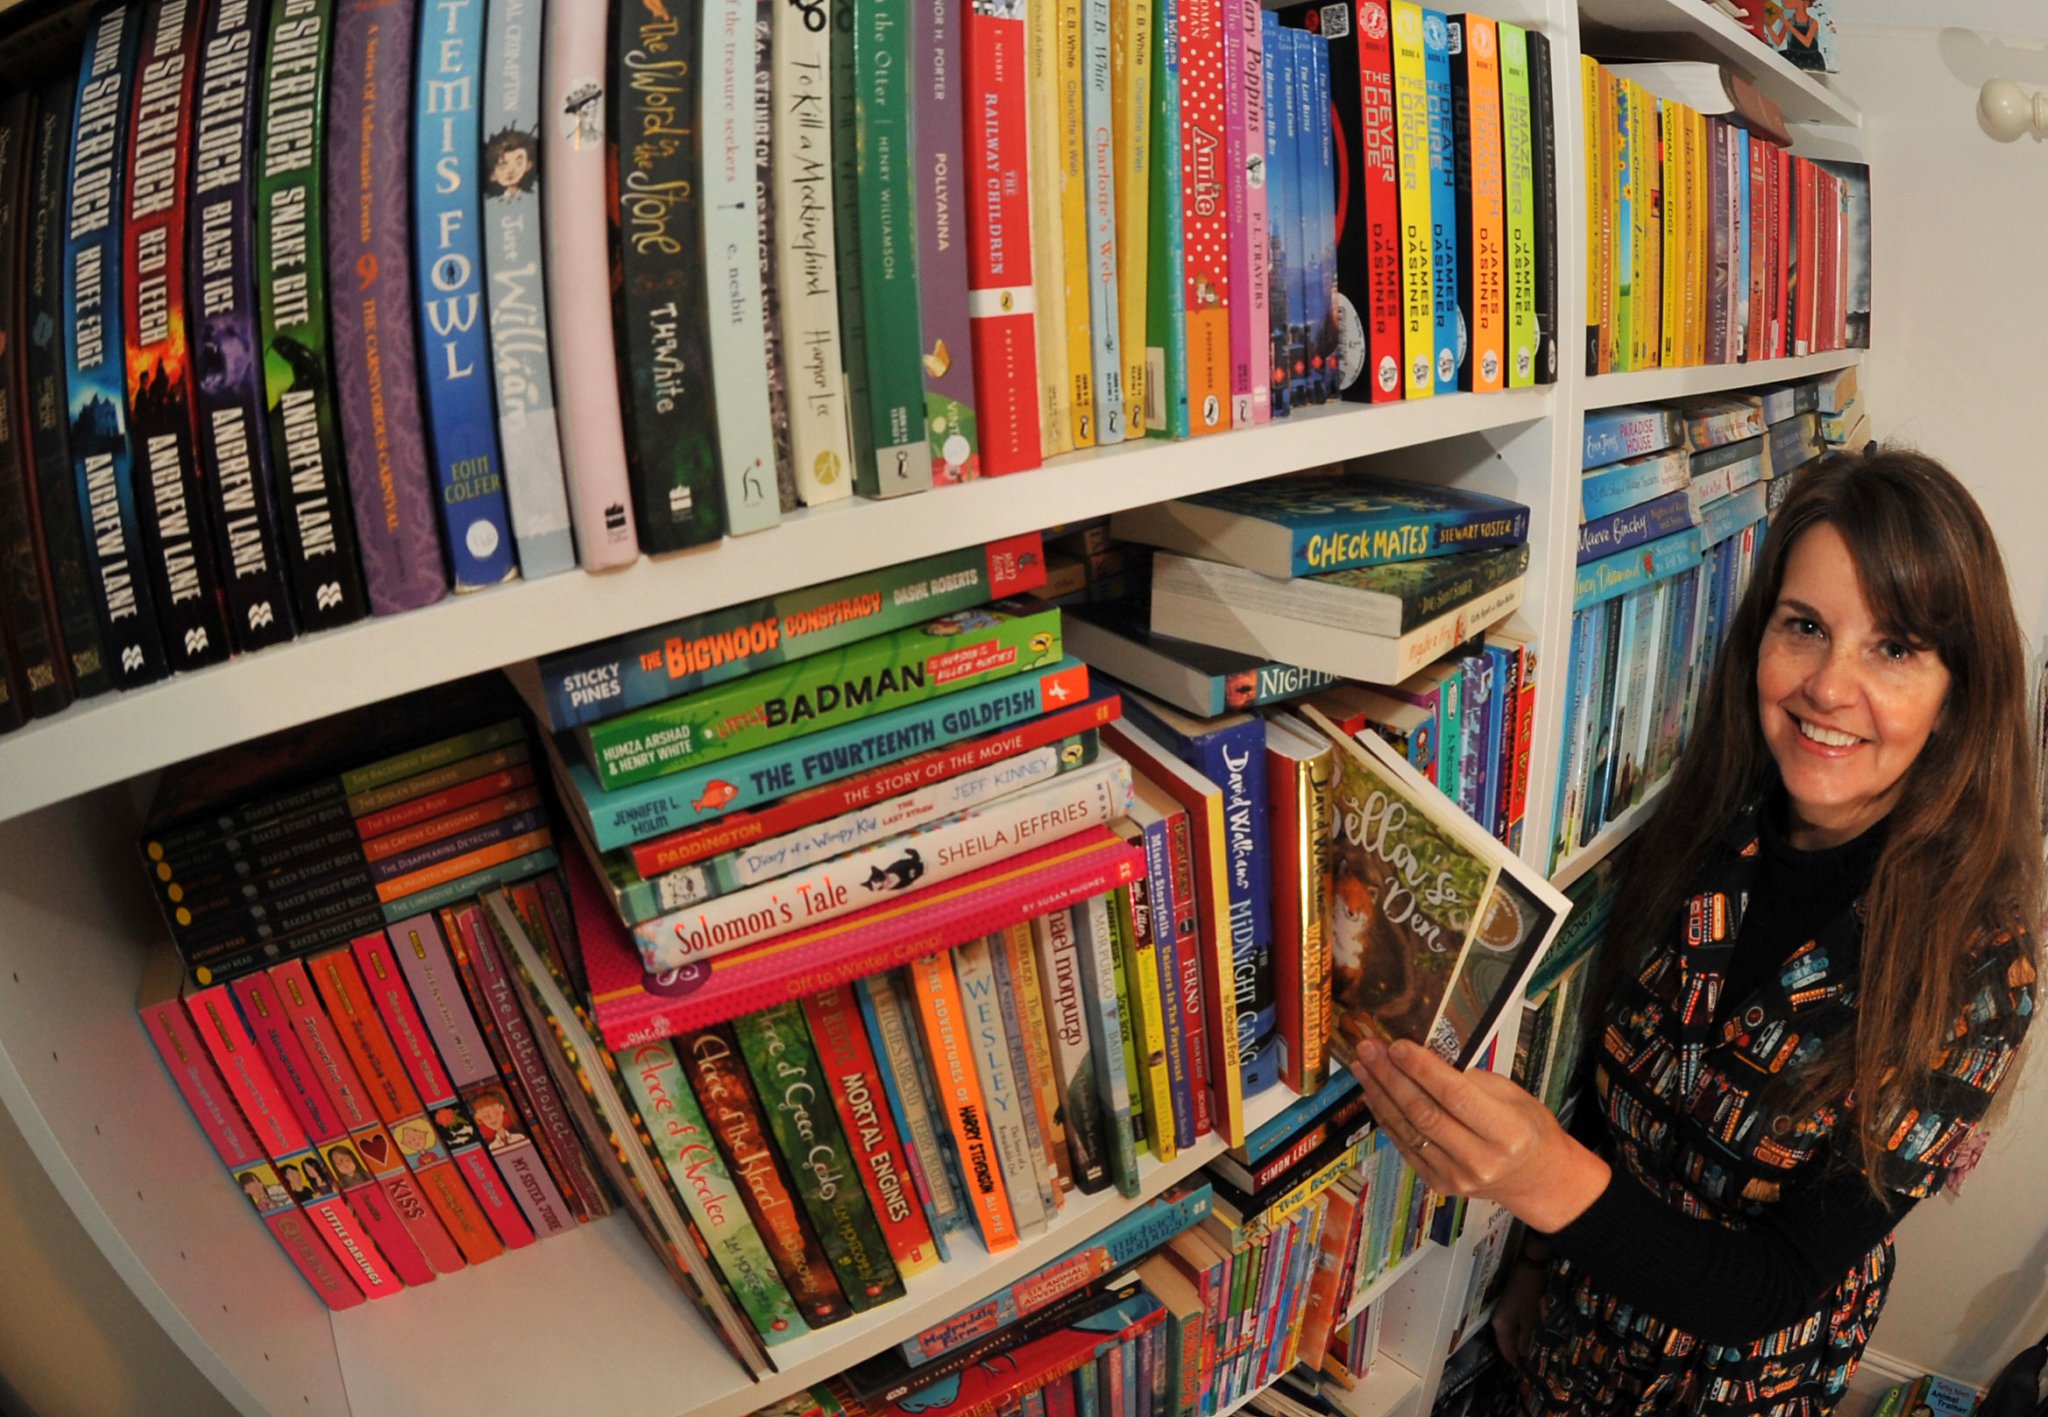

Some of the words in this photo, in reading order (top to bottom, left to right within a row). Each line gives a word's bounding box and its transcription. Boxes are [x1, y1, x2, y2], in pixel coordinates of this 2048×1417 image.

[92, 5, 127, 77] YOUNG
[639, 17, 679, 53] The
[725, 7, 740, 35] the
[875, 15, 893, 44] the
[265, 16, 321, 178] SHERLOCK
[625, 51, 690, 136] Sword
[725, 41, 737, 112] treasure
[791, 56, 821, 87] To
[874, 50, 893, 107] Otter
[934, 48, 945, 100] PORTER
[1363, 69, 1391, 86] THE
[1426, 79, 1450, 93] THE
[132, 53, 186, 221] SHERLOCK
[196, 28, 250, 194] SHERLOCK
[790, 92, 825, 130] Kill
[799, 135, 813, 149] a
[985, 93, 1001, 174] RAILWAY
[1364, 86, 1381, 168] CODE
[1379, 85, 1396, 183] FEVER
[1427, 92, 1442, 171] CURE
[1439, 92, 1454, 188] DEATH
[1518, 104, 1531, 181] MAZE
[1664, 107, 1673, 162] WOMAN
[70, 73, 121, 240] SHERLOCK
[634, 143, 660, 171] the
[725, 116, 745, 184] seekers
[878, 136, 890, 183] HENRY
[1005, 171, 1016, 196] THE
[1508, 104, 1523, 217] RUNNER
[202, 200, 233, 270] BLACK
[270, 185, 306, 270] SNAKE
[621, 170, 691, 255] Stone
[791, 154, 830, 296] Mockingbird
[879, 189, 894, 281] WILLIAMSON
[936, 153, 948, 251] POLLYANNA
[987, 178, 1004, 275] CHILDREN
[1666, 202, 1674, 237] EDGE
[75, 245, 102, 311] KNIFE
[138, 227, 168, 273] RED
[356, 252, 379, 292] 9
[1373, 224, 1386, 335] DASHNER
[1385, 240, 1397, 318] JAMES
[1407, 225, 1419, 334] DASHNER
[1418, 241, 1429, 317] JAMES
[1433, 224, 1445, 329] DASHNER
[1444, 242, 1455, 313] JAMES
[1479, 228, 1489, 330] DASHNER
[1489, 242, 1500, 315] JAMES
[1513, 228, 1523, 329] DASHNER
[1522, 243, 1532, 313] JAMES
[139, 279, 168, 347] LEECH
[204, 275, 234, 317] ICE
[272, 276, 309, 331] BITE
[426, 210, 481, 381] FOWL
[1714, 295, 1723, 358] VISITOR
[804, 330, 832, 389] Harper
[807, 393, 835, 417] Lee
[1620, 419, 1654, 440] PARADISE
[211, 406, 255, 513] ANDREW
[282, 389, 328, 495] ANDREW
[1625, 438, 1652, 453] HOUSE
[84, 452, 126, 556] ANDREW
[147, 433, 191, 537] ANDREW
[444, 475, 500, 504] COLFER
[226, 513, 268, 580] LANE
[295, 497, 336, 561] LANE
[1307, 532, 1370, 567] CHECK
[1373, 523, 1430, 558] MATES
[1440, 523, 1480, 545] STEWART
[1480, 519, 1512, 539] FOSTER
[1577, 529, 1611, 551] Maeve
[1613, 515, 1648, 543] Binchy
[100, 556, 138, 624] LANE
[162, 540, 202, 605] LANE
[640, 650, 663, 673] THE
[664, 618, 782, 680] BIGWOOF
[783, 591, 883, 638] CONSPIRACY
[930, 567, 979, 596] ROBERTS
[563, 662, 620, 692] STICKY
[571, 680, 622, 708] PINES
[716, 708, 766, 740] LITTLE
[764, 662, 928, 729] BADMAN
[603, 739, 640, 762] HUMZA
[640, 725, 691, 752] ARSHAD
[608, 762, 619, 776] &
[620, 748, 658, 774] HENRY
[658, 739, 694, 763] WHITE
[750, 766, 798, 797] THE
[801, 724, 936, 785] FOURTEENTH
[940, 689, 1037, 733] GOLDFISH
[843, 787, 873, 806] THE
[875, 772, 922, 800] STORY
[924, 765, 945, 783] OF
[949, 752, 980, 776] THE
[979, 733, 1024, 762] MOVIE
[1222, 745, 1250, 803] David
[951, 775, 987, 802] JEFF
[993, 756, 1050, 787] KINNEY
[612, 801, 665, 829] JENNIFER
[630, 813, 671, 837] HOLM
[656, 822, 764, 867] PADDINGTON
[746, 847, 789, 873] Diary
[813, 825, 855, 855] Wimpy
[855, 817, 878, 836] Kid
[1228, 797, 1250, 889] Walliams
[673, 890, 794, 958] Solomon's
[796, 875, 849, 915] Tale
[937, 829, 1009, 867] SHEILA
[1013, 801, 1090, 844] JEFFRIES
[1021, 902, 1035, 914] BY
[1037, 891, 1063, 909] SUSAN
[1065, 876, 1107, 900] HUGHES
[320, 922, 360, 942] STREET
[361, 913, 380, 929] BOYS
[1382, 876, 1446, 953] Den
[786, 974, 816, 996] Off
[818, 970, 834, 988] to
[836, 954, 891, 984] Winter
[893, 934, 945, 963] Camp!
[929, 965, 942, 993] THE
[1230, 899, 1256, 1006] MIDNIGHT
[1303, 921, 1321, 983] WORST
[1058, 955, 1084, 1045] morpurgo
[1303, 985, 1321, 1070] CHILDREN
[304, 1016, 341, 1085] Jacqueline
[339, 1084, 363, 1122] Wilson
[489, 979, 511, 1014] The
[505, 1016, 538, 1075] Lottie
[532, 1074, 568, 1142] Project
[693, 1034, 730, 1102] Anne
[936, 998, 965, 1083] ADVENTURES
[965, 975, 1009, 1113] WESLEY
[1235, 1010, 1258, 1068] GANG
[634, 1045, 674, 1113] Anne
[955, 1085, 968, 1102] OF
[666, 1121, 698, 1139] of
[720, 1104, 742, 1124] of
[727, 1122, 747, 1153] the
[961, 1105, 982, 1142] HARRY
[736, 1150, 787, 1213] Island
[842, 1073, 880, 1150] MORTAL
[868, 1151, 909, 1223] ENGINES
[966, 1143, 995, 1194] STEVENSON
[1260, 1155, 1291, 1185] SIMON
[1293, 1135, 1318, 1161] LELIC
[387, 1178, 425, 1222] KISS
[512, 1157, 525, 1177] MY
[519, 1176, 546, 1210] SISTER
[536, 1206, 562, 1233] JODIE
[677, 1143, 728, 1228] Avonlea
[986, 1192, 998, 1211] ALI
[276, 1215, 341, 1292] QUEENIE
[319, 1205, 351, 1245] LITTLE
[341, 1238, 383, 1288] DARLINGS
[991, 1212, 1004, 1234] PYE
[1113, 1213, 1175, 1252] michael
[1931, 1390, 1959, 1404] Animal
[1939, 1400, 1967, 1413] Trainer
